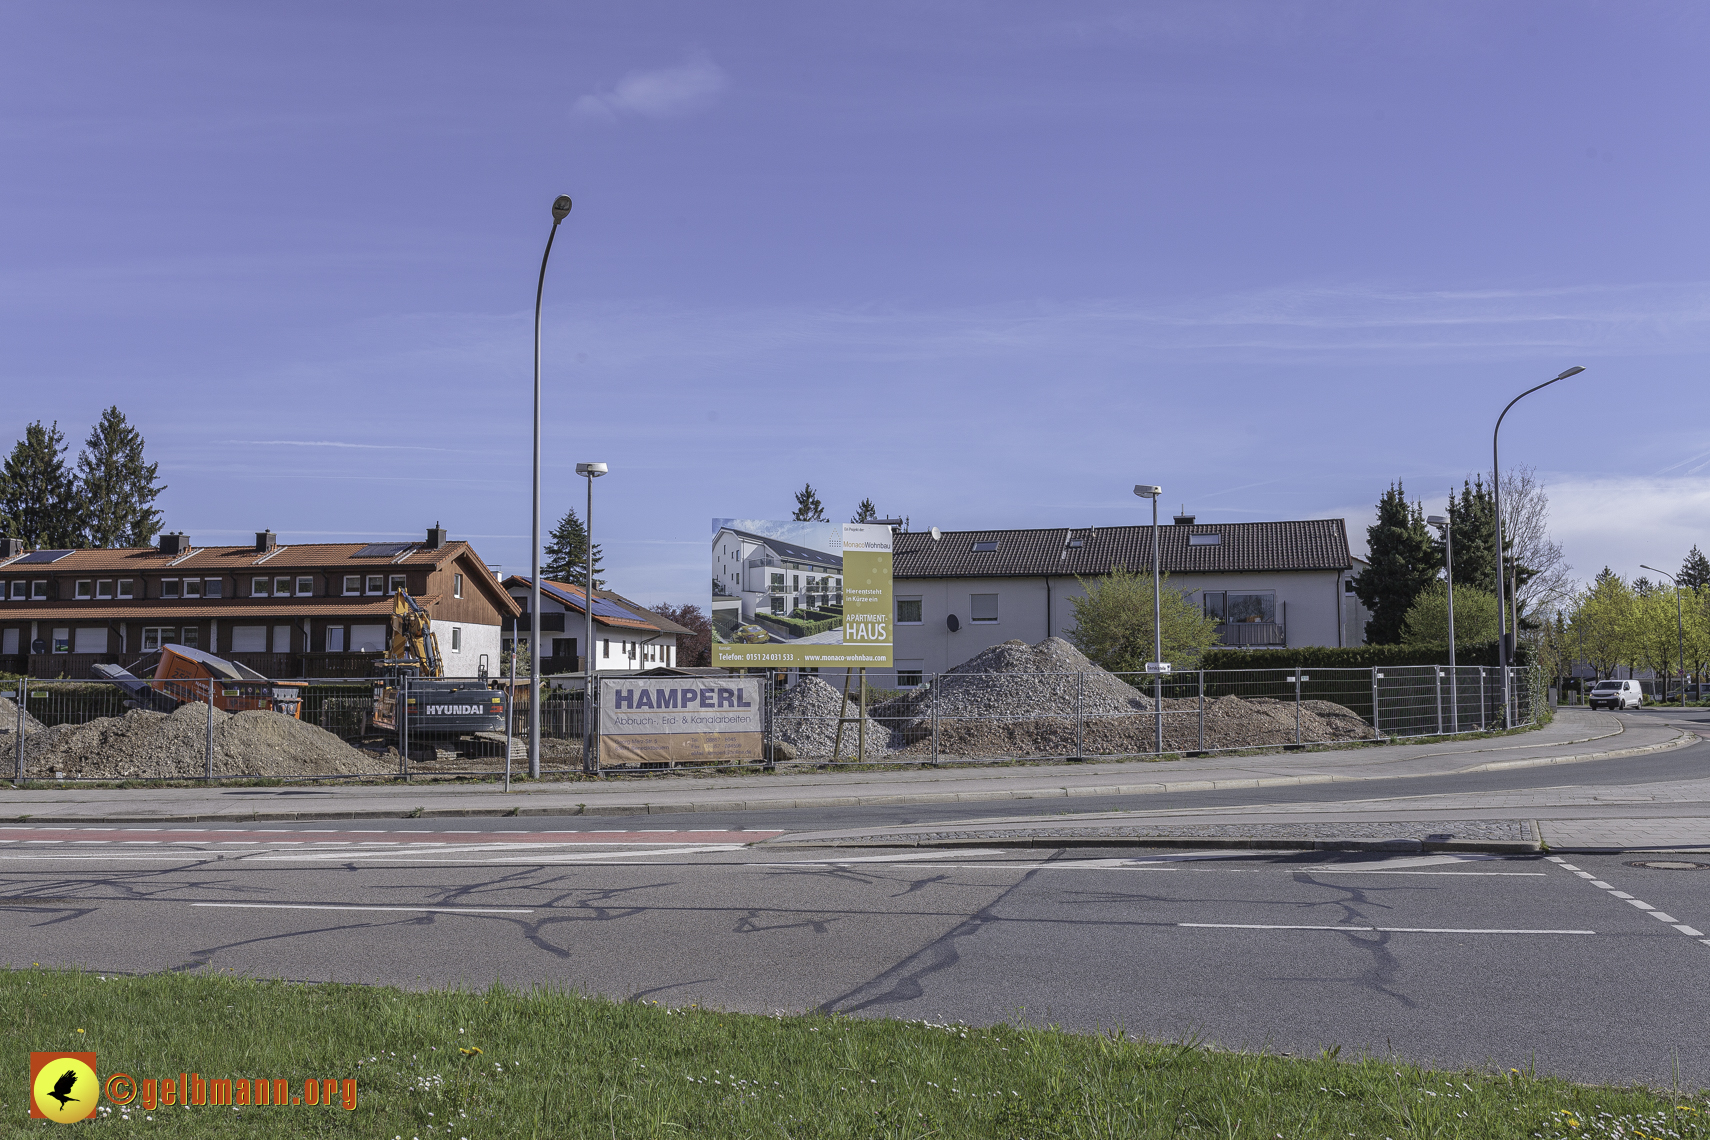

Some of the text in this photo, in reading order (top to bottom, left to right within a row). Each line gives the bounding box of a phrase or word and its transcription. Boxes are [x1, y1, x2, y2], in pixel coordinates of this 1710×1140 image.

[843, 541, 890, 549] MonacoWohnbau
[846, 614, 888, 622] APARTMENT-
[846, 623, 886, 640] HAUS
[614, 688, 752, 709] HAMPERL
[426, 705, 483, 714] HYUNDAI
[614, 715, 752, 726] Abbruch-, Erd- & Kanalarbeiten
